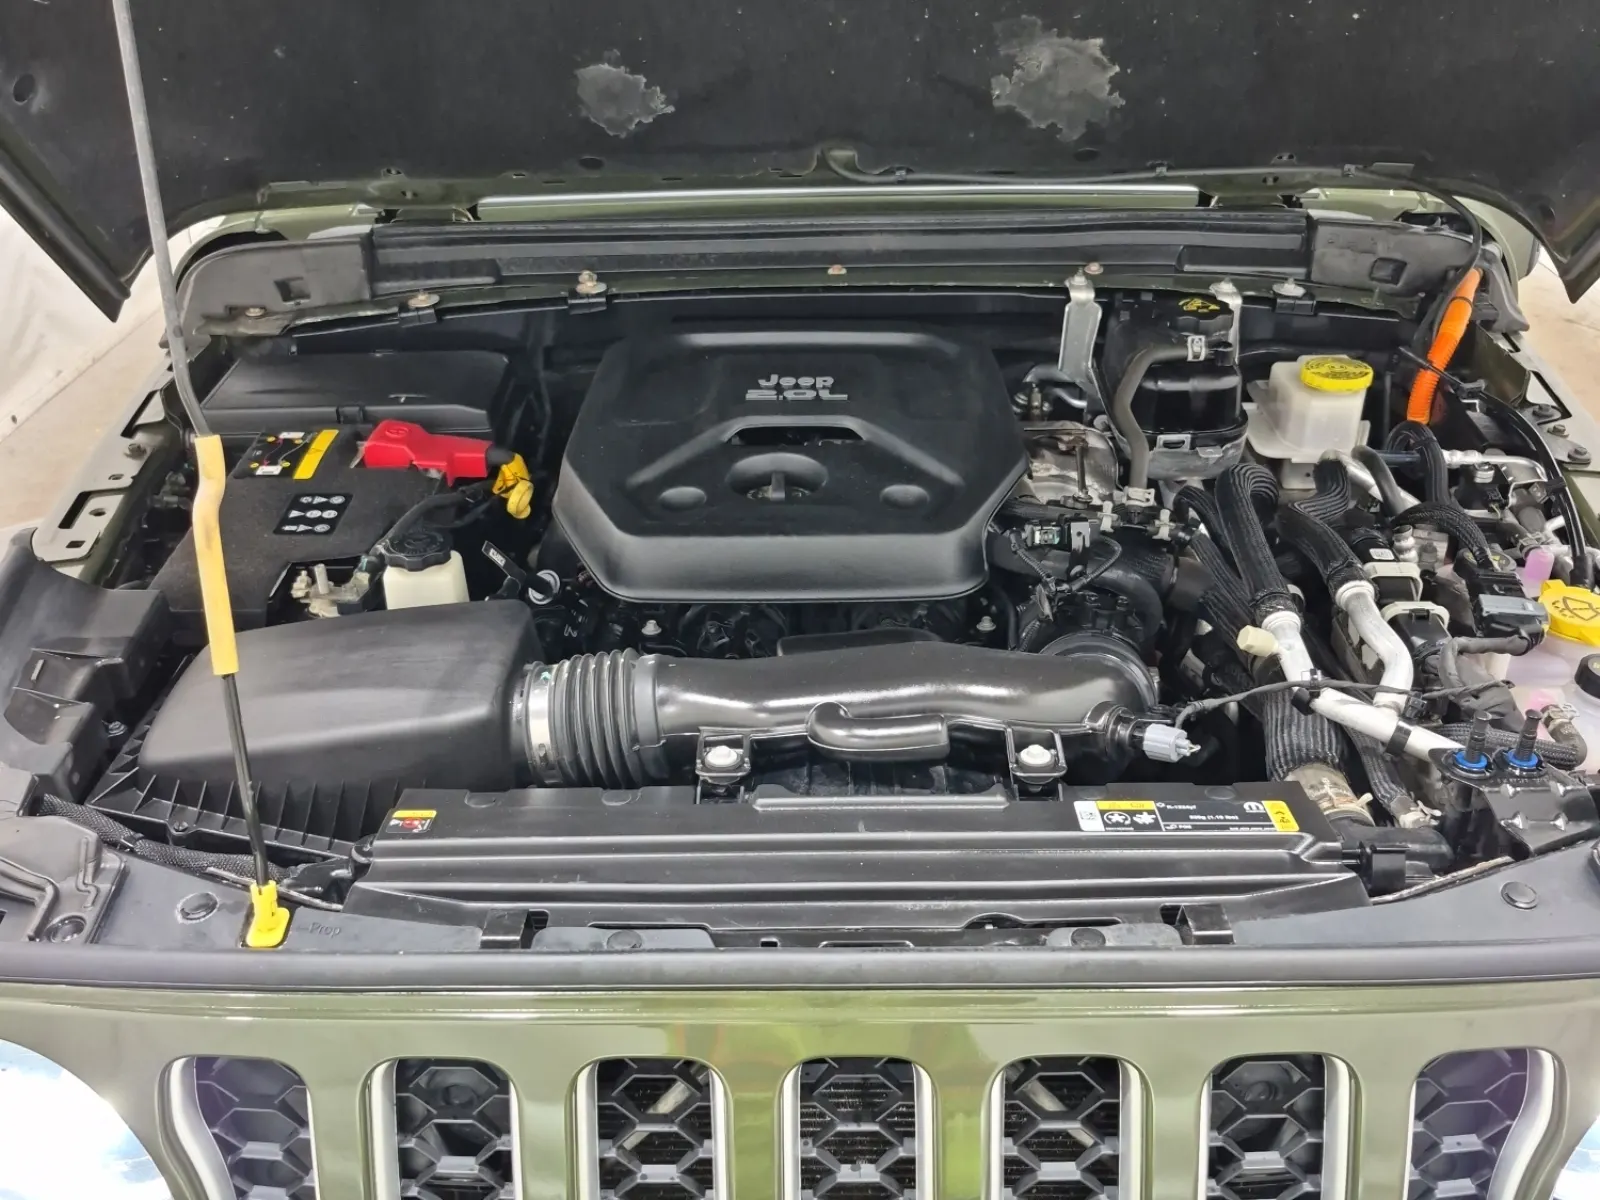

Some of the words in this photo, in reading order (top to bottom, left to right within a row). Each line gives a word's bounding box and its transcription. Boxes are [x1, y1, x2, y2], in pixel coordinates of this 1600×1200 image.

[757, 374, 834, 389] Jeep
[745, 389, 848, 401] 2.0L
[309, 922, 342, 939] Prop
